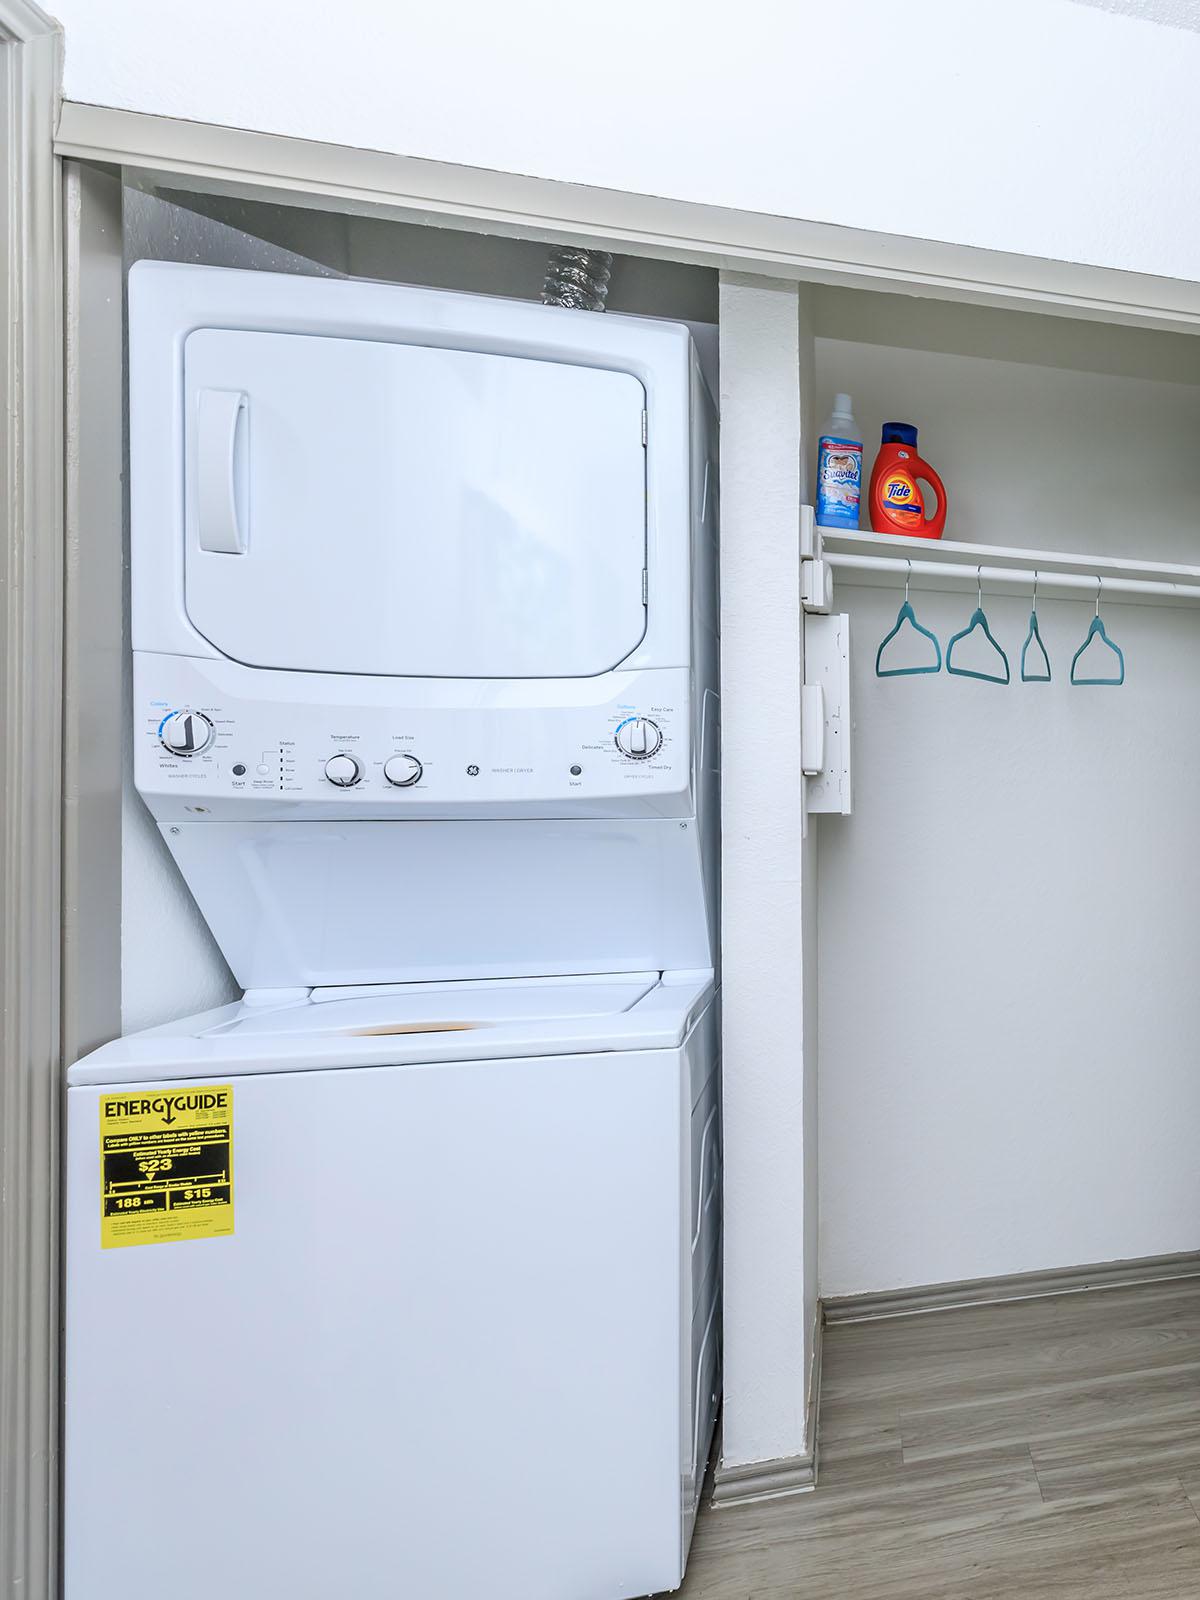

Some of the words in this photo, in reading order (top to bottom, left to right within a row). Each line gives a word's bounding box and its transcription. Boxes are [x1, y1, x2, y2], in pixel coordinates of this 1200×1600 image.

[823, 468, 858, 481] Suavitel
[888, 482, 911, 499] Tide
[105, 1093, 228, 1118] ENERGYGUIDE
[138, 1158, 173, 1173] $23
[184, 1188, 211, 1200] $15
[115, 1197, 141, 1208] 188
